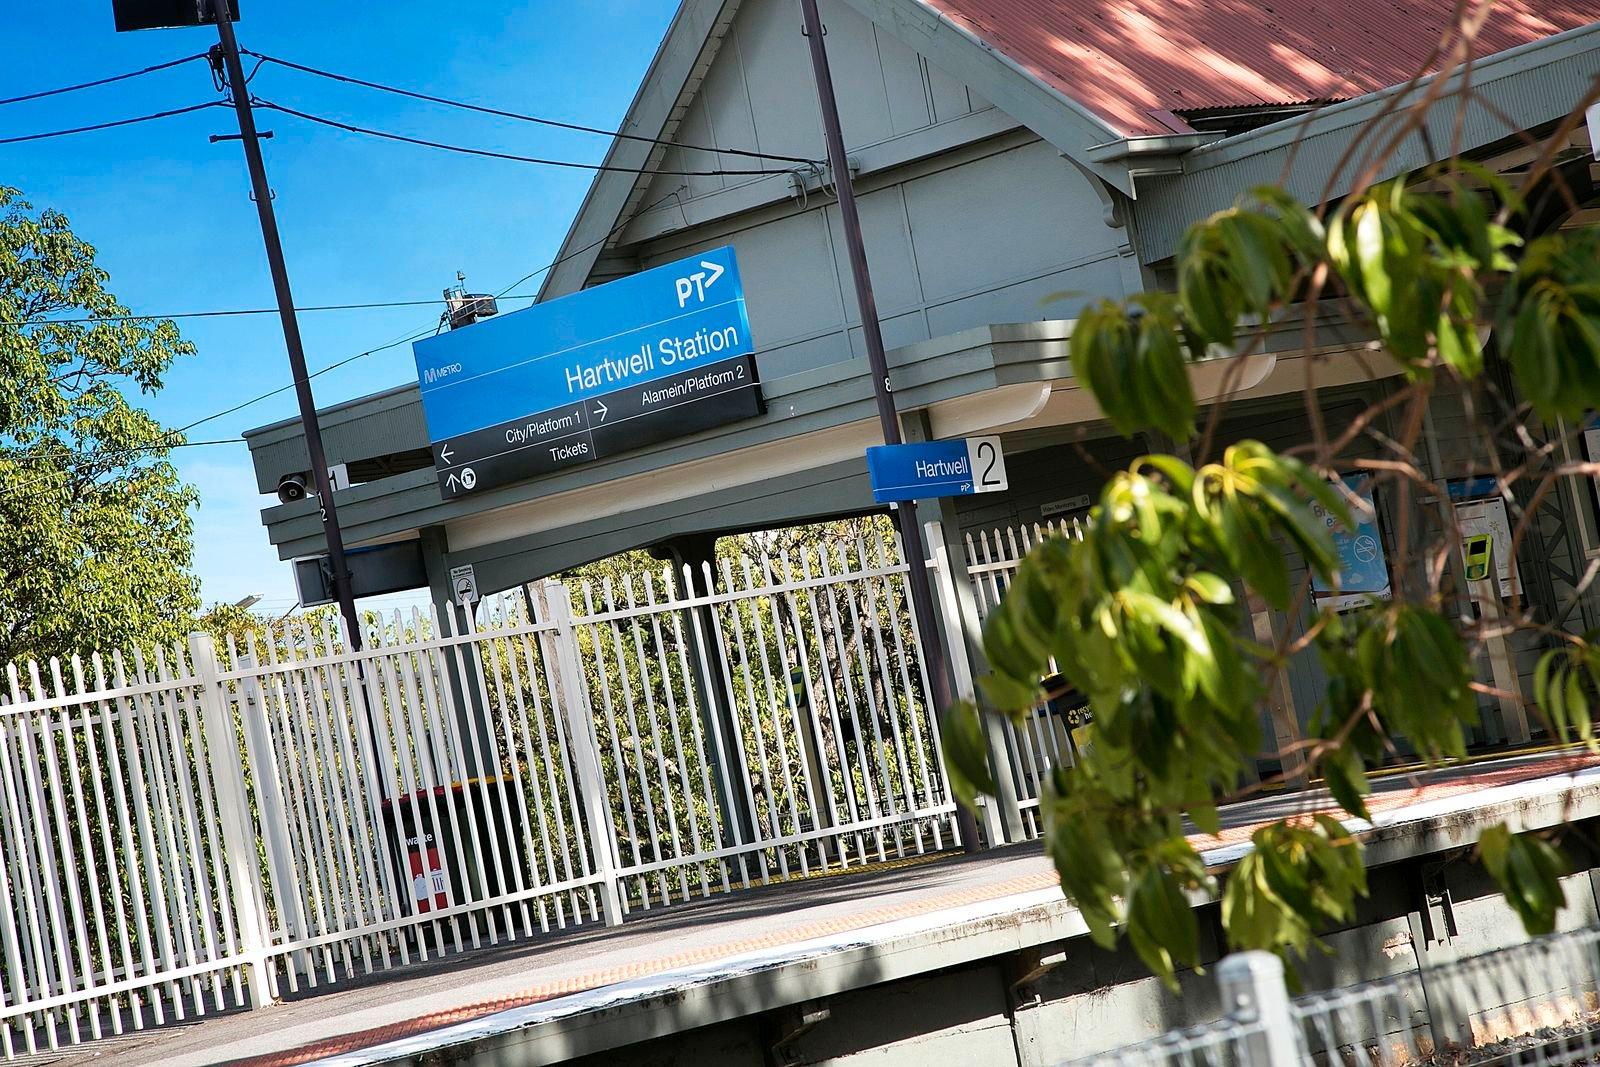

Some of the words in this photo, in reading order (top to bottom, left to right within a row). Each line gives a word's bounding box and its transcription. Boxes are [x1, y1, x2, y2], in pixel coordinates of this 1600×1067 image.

[565, 345, 653, 393] Hartwell
[659, 325, 739, 366] Station
[641, 370, 735, 406] Alamein/Platform
[736, 365, 745, 379] 2
[505, 413, 572, 444] City/Platform
[574, 411, 581, 424] 1
[549, 441, 588, 463] Tickets
[915, 456, 969, 478] Hartwell
[977, 441, 1001, 486] 2
